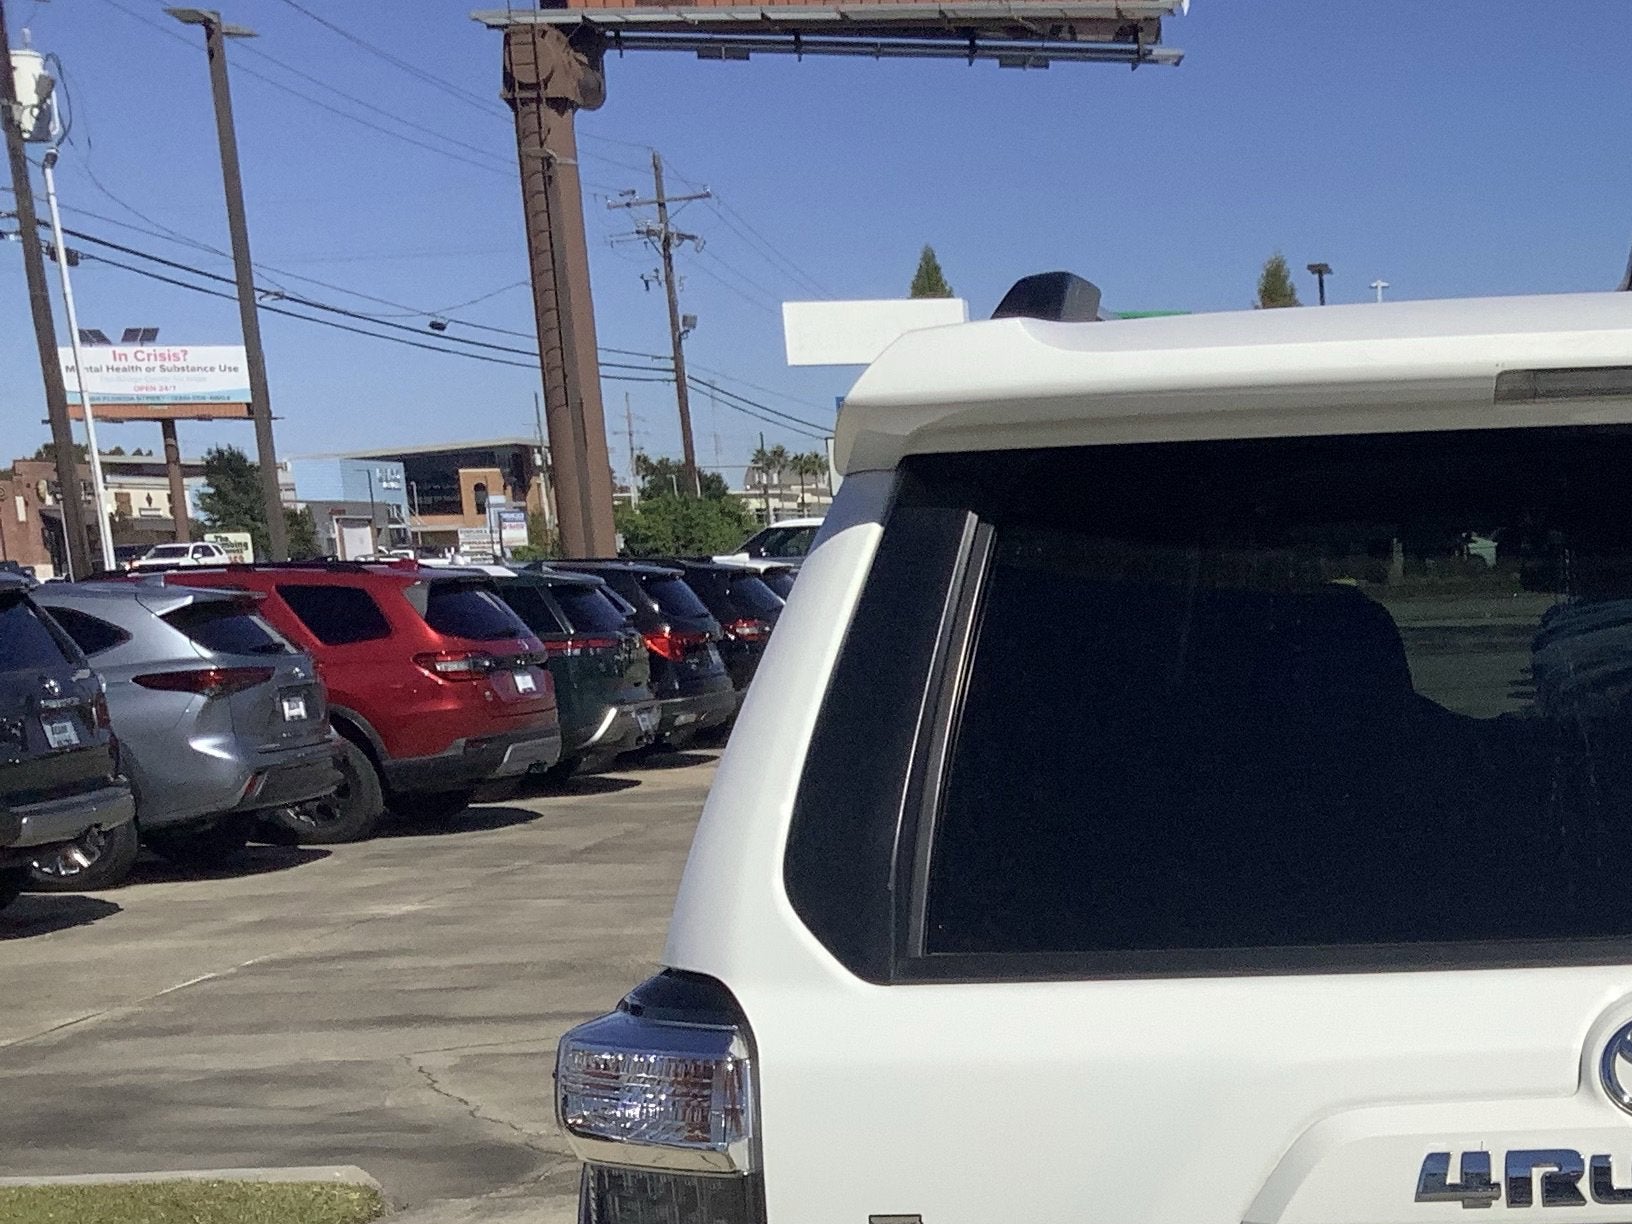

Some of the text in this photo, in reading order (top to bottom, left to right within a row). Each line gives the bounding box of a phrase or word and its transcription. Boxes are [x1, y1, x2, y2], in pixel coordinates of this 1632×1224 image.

[112, 348, 188, 362] In Crisis?
[65, 364, 239, 373] Mntal Health or Substance Use
